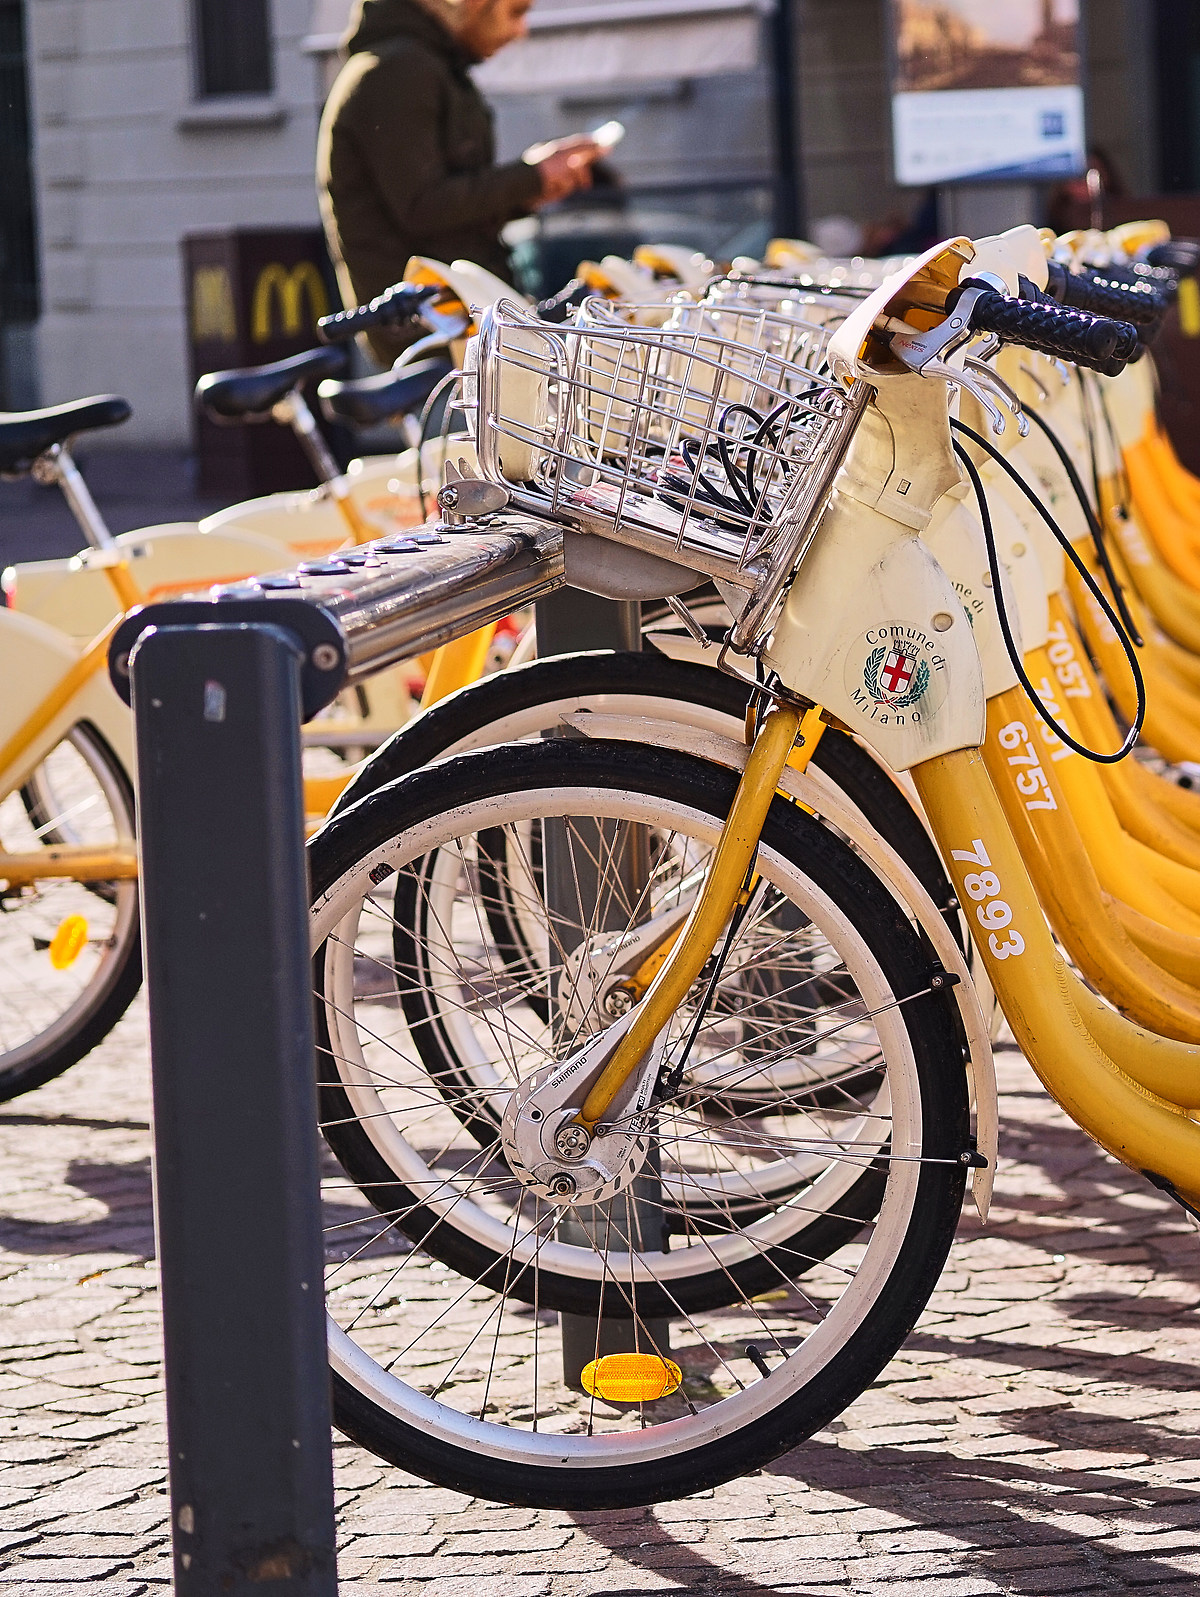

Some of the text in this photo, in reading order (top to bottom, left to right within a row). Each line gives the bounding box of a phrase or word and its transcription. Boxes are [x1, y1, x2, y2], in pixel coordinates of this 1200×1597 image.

[866, 625, 946, 671] Comune di
[1047, 620, 1092, 699] 7057
[850, 688, 921, 725] Milano
[998, 720, 1058, 811] 6757
[950, 838, 1026, 960] 7893
[551, 1056, 588, 1089] SHIMANO
